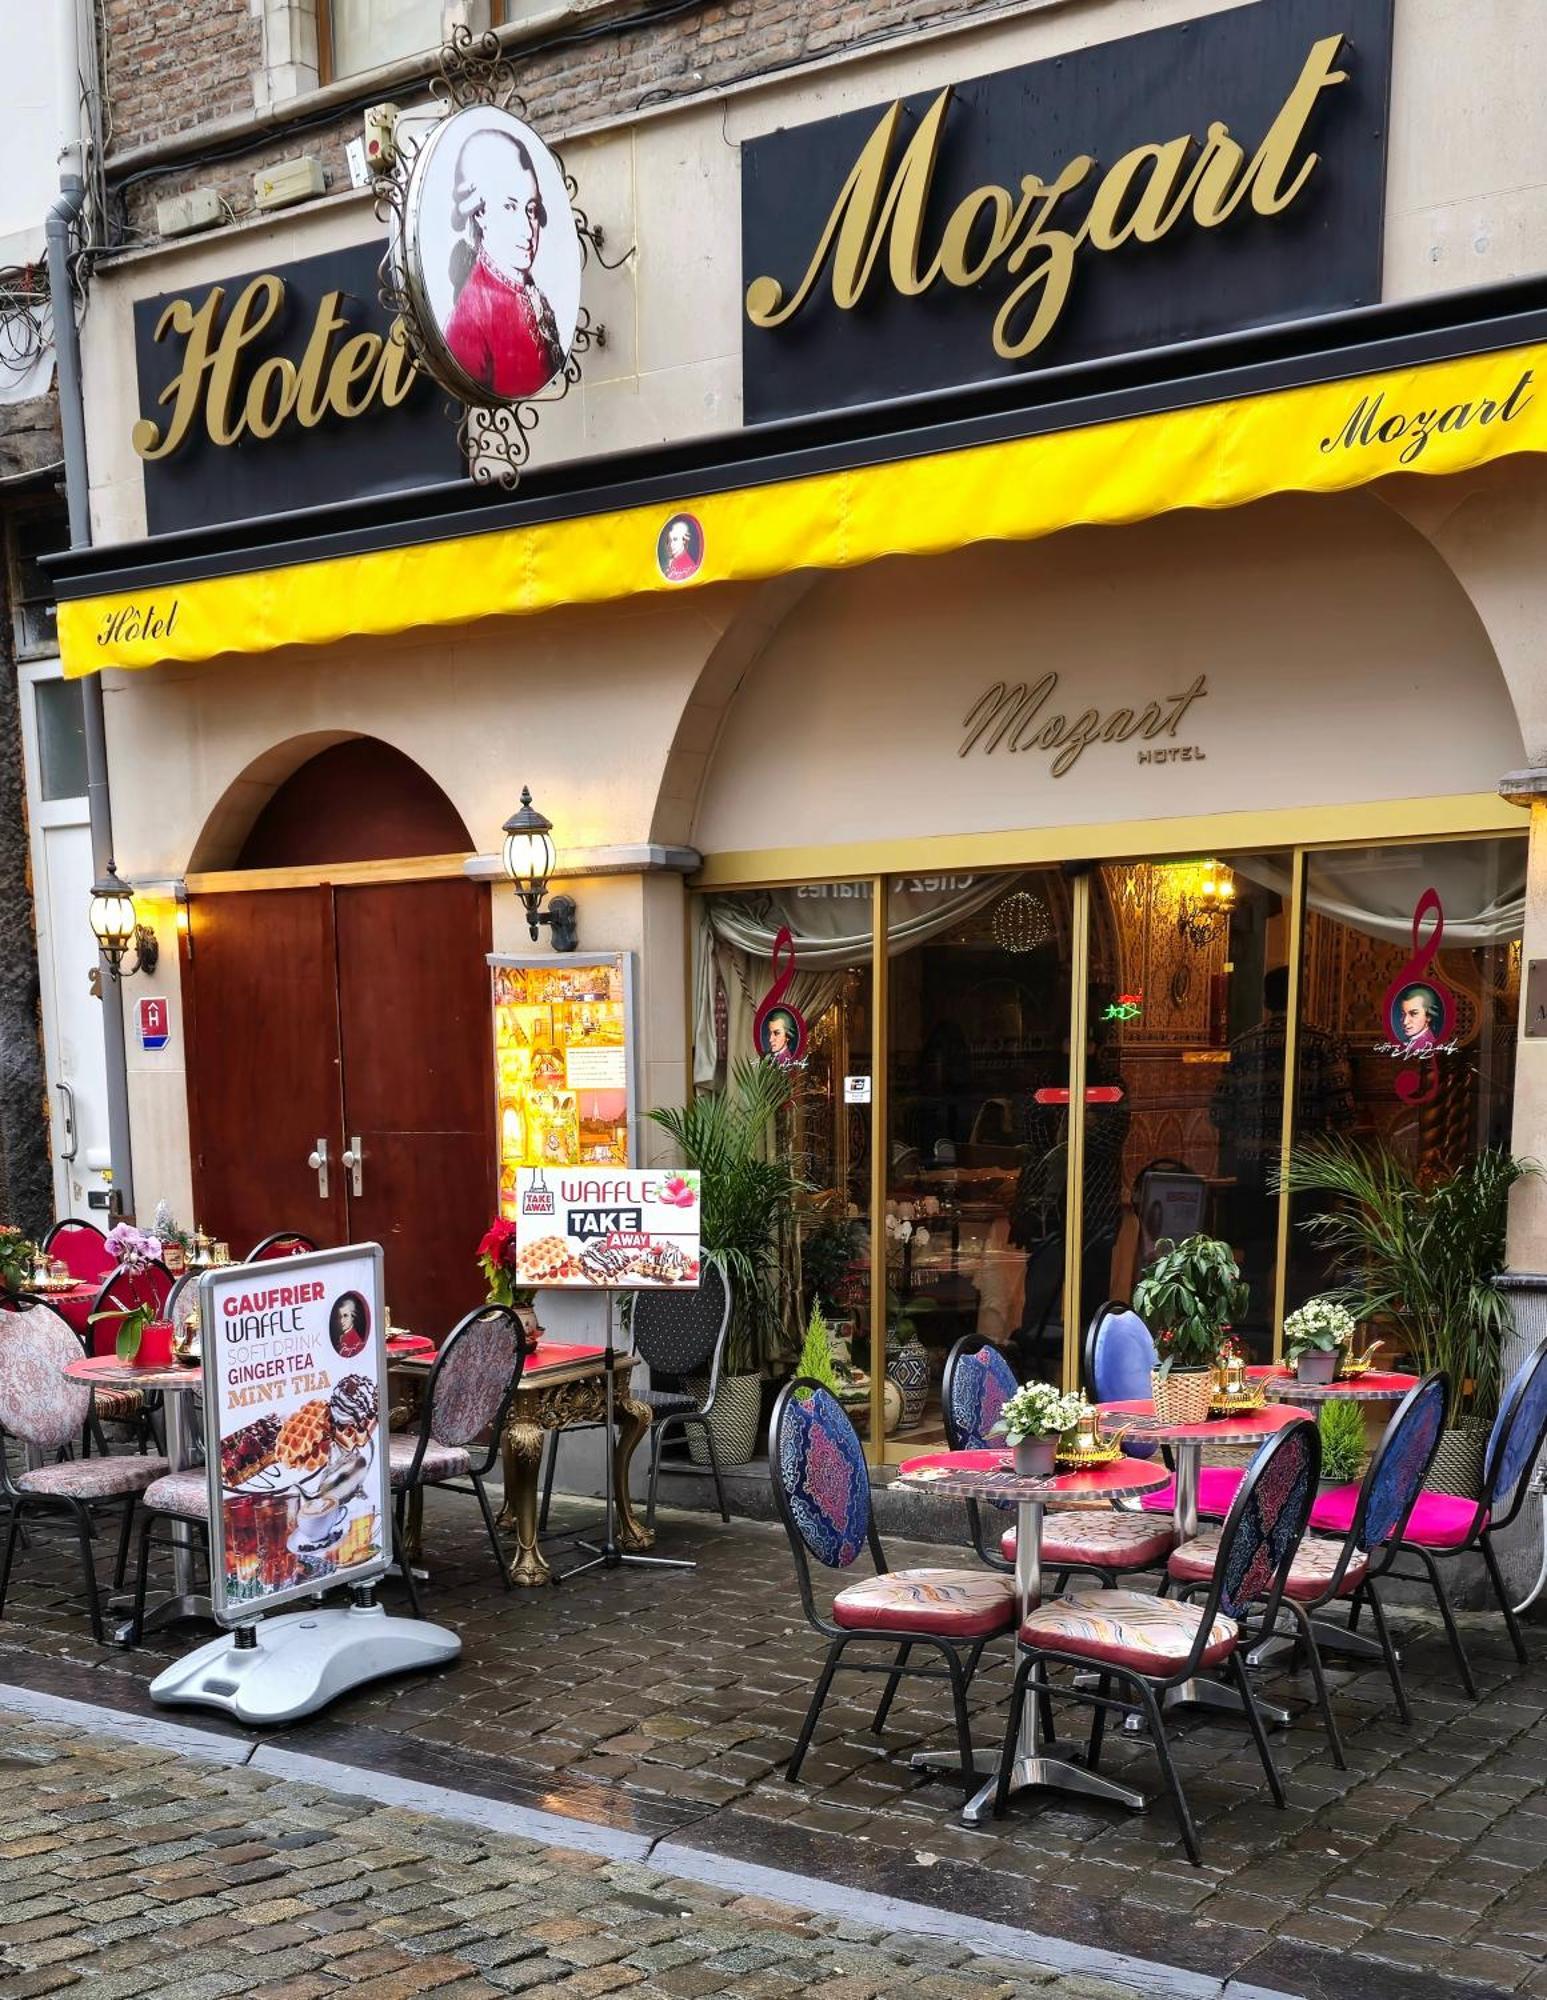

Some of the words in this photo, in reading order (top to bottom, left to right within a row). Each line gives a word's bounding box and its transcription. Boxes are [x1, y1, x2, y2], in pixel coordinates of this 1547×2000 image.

[746, 33, 1349, 359] Mozart
[1320, 369, 1535, 464] Mozart
[97, 600, 178, 646] Hôtel
[958, 671, 1208, 778] Mozart
[1138, 746, 1206, 765] HOTEL
[526, 1194, 551, 1204] TAKE
[526, 1203, 552, 1212] AWAY
[561, 1180, 657, 1204] WAFFLE
[570, 1211, 637, 1233] TAKE
[610, 1233, 648, 1248] AWAY
[223, 1281, 325, 1317] GAUFRIER
[225, 1306, 305, 1343] WAFFLE
[228, 1343, 269, 1366] SOFT
[273, 1332, 322, 1357] DRINK
[228, 1359, 285, 1386] GINGER
[287, 1353, 315, 1373] TEA
[291, 1370, 331, 1396] TEA
